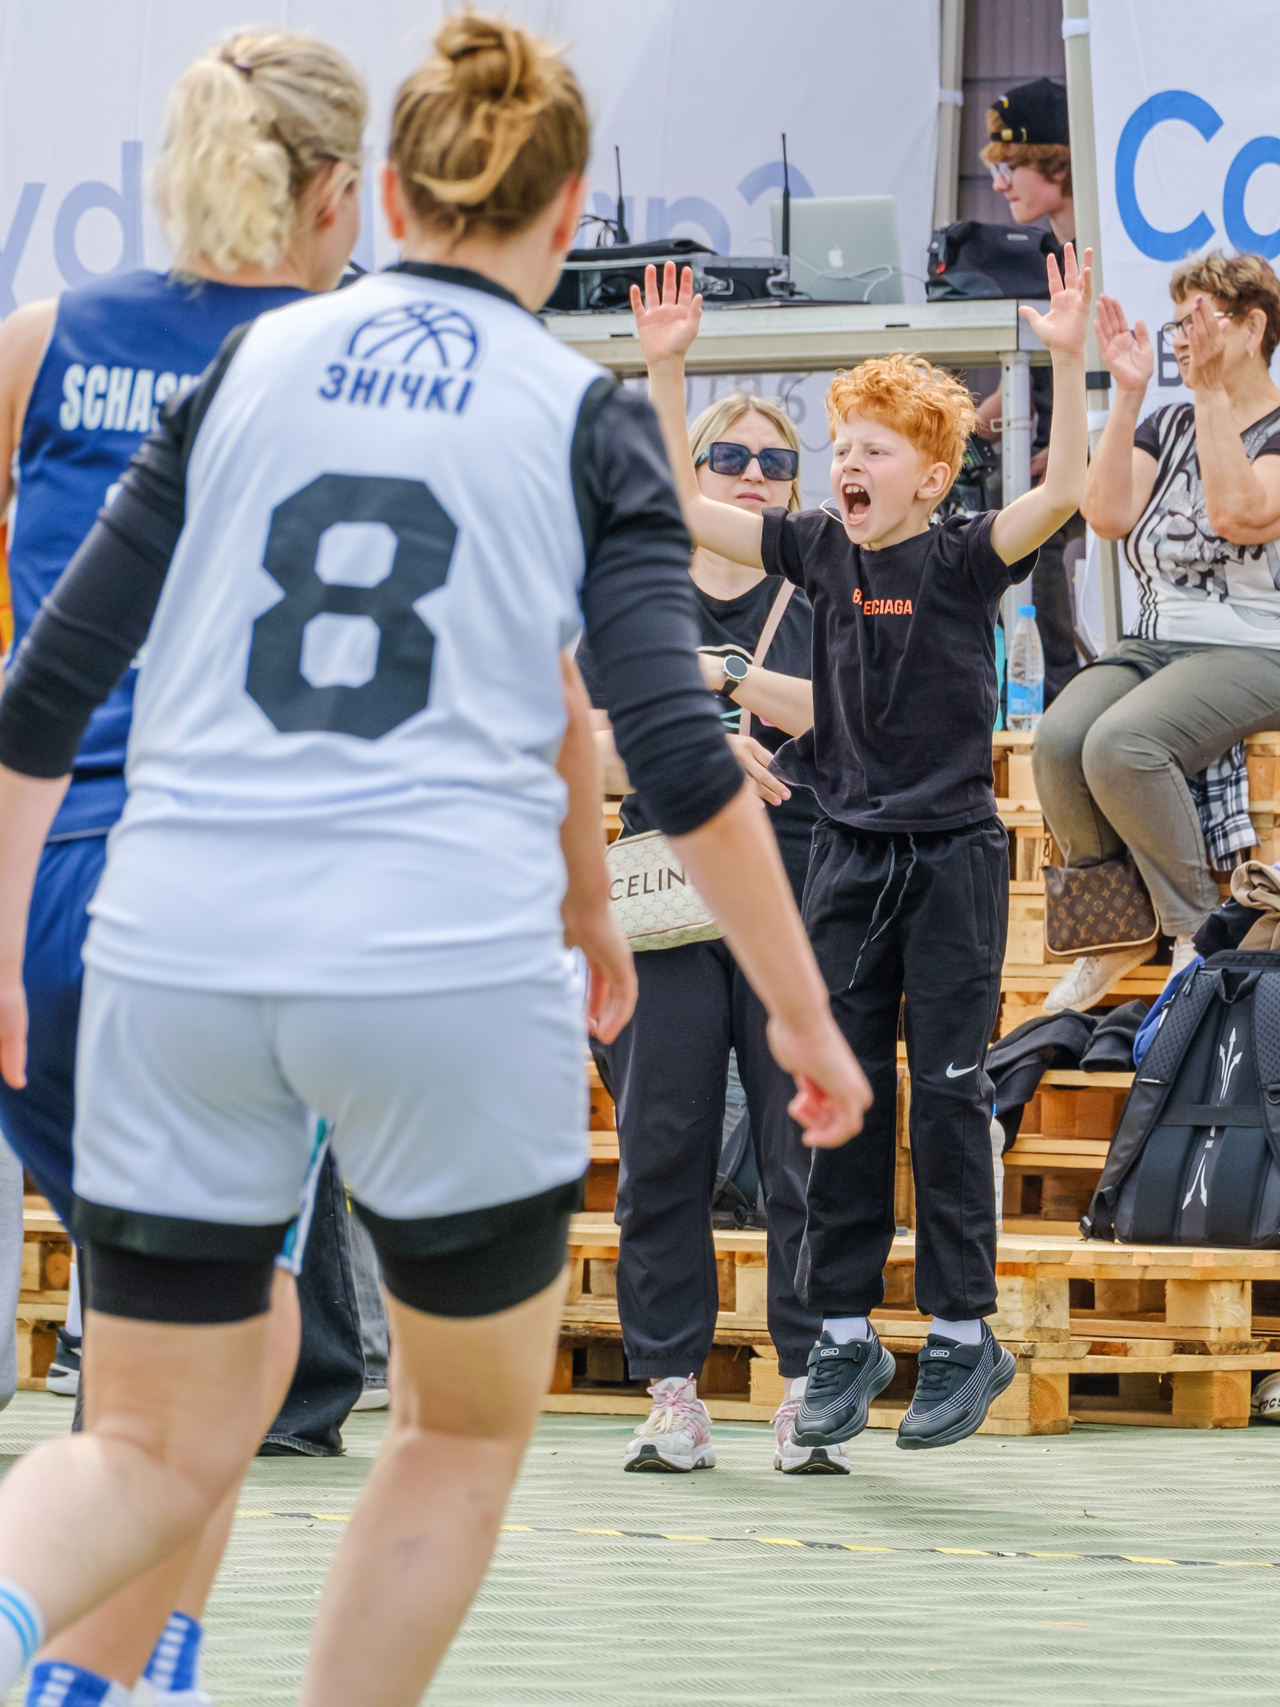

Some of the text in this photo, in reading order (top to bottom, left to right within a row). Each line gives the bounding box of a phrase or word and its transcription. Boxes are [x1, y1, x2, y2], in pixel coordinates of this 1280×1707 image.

[59, 363, 202, 433] SCHAS
[319, 364, 474, 415] ЗНІЧКІ
[245, 473, 458, 741] 8
[608, 867, 687, 901] CELIN
